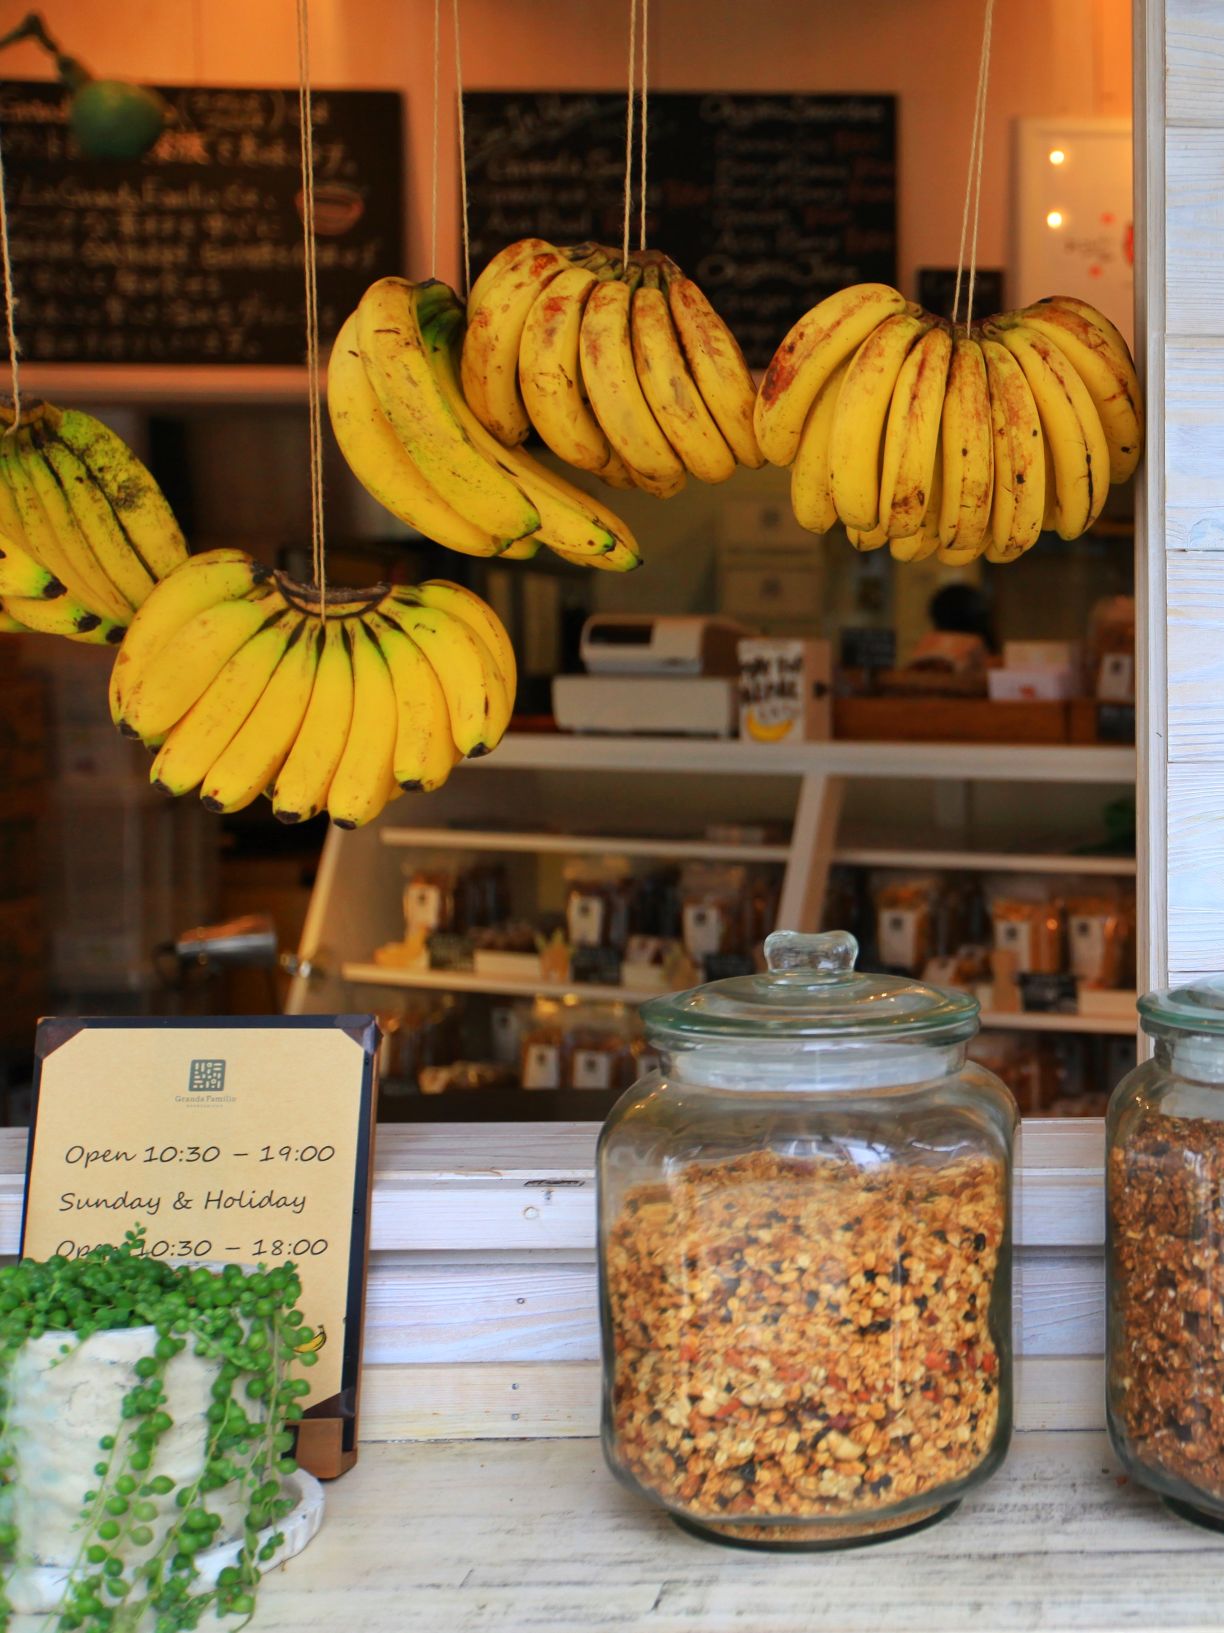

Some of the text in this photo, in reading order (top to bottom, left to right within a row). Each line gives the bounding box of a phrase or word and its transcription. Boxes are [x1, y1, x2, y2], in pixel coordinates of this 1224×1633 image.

[65, 1146, 137, 1168] Open
[144, 1146, 221, 1163] 10:30
[259, 1145, 335, 1162] 19:00
[59, 1190, 306, 1216] Sunday & Holiday
[131, 1239, 212, 1257] 10:30
[252, 1239, 329, 1256] 18:00
